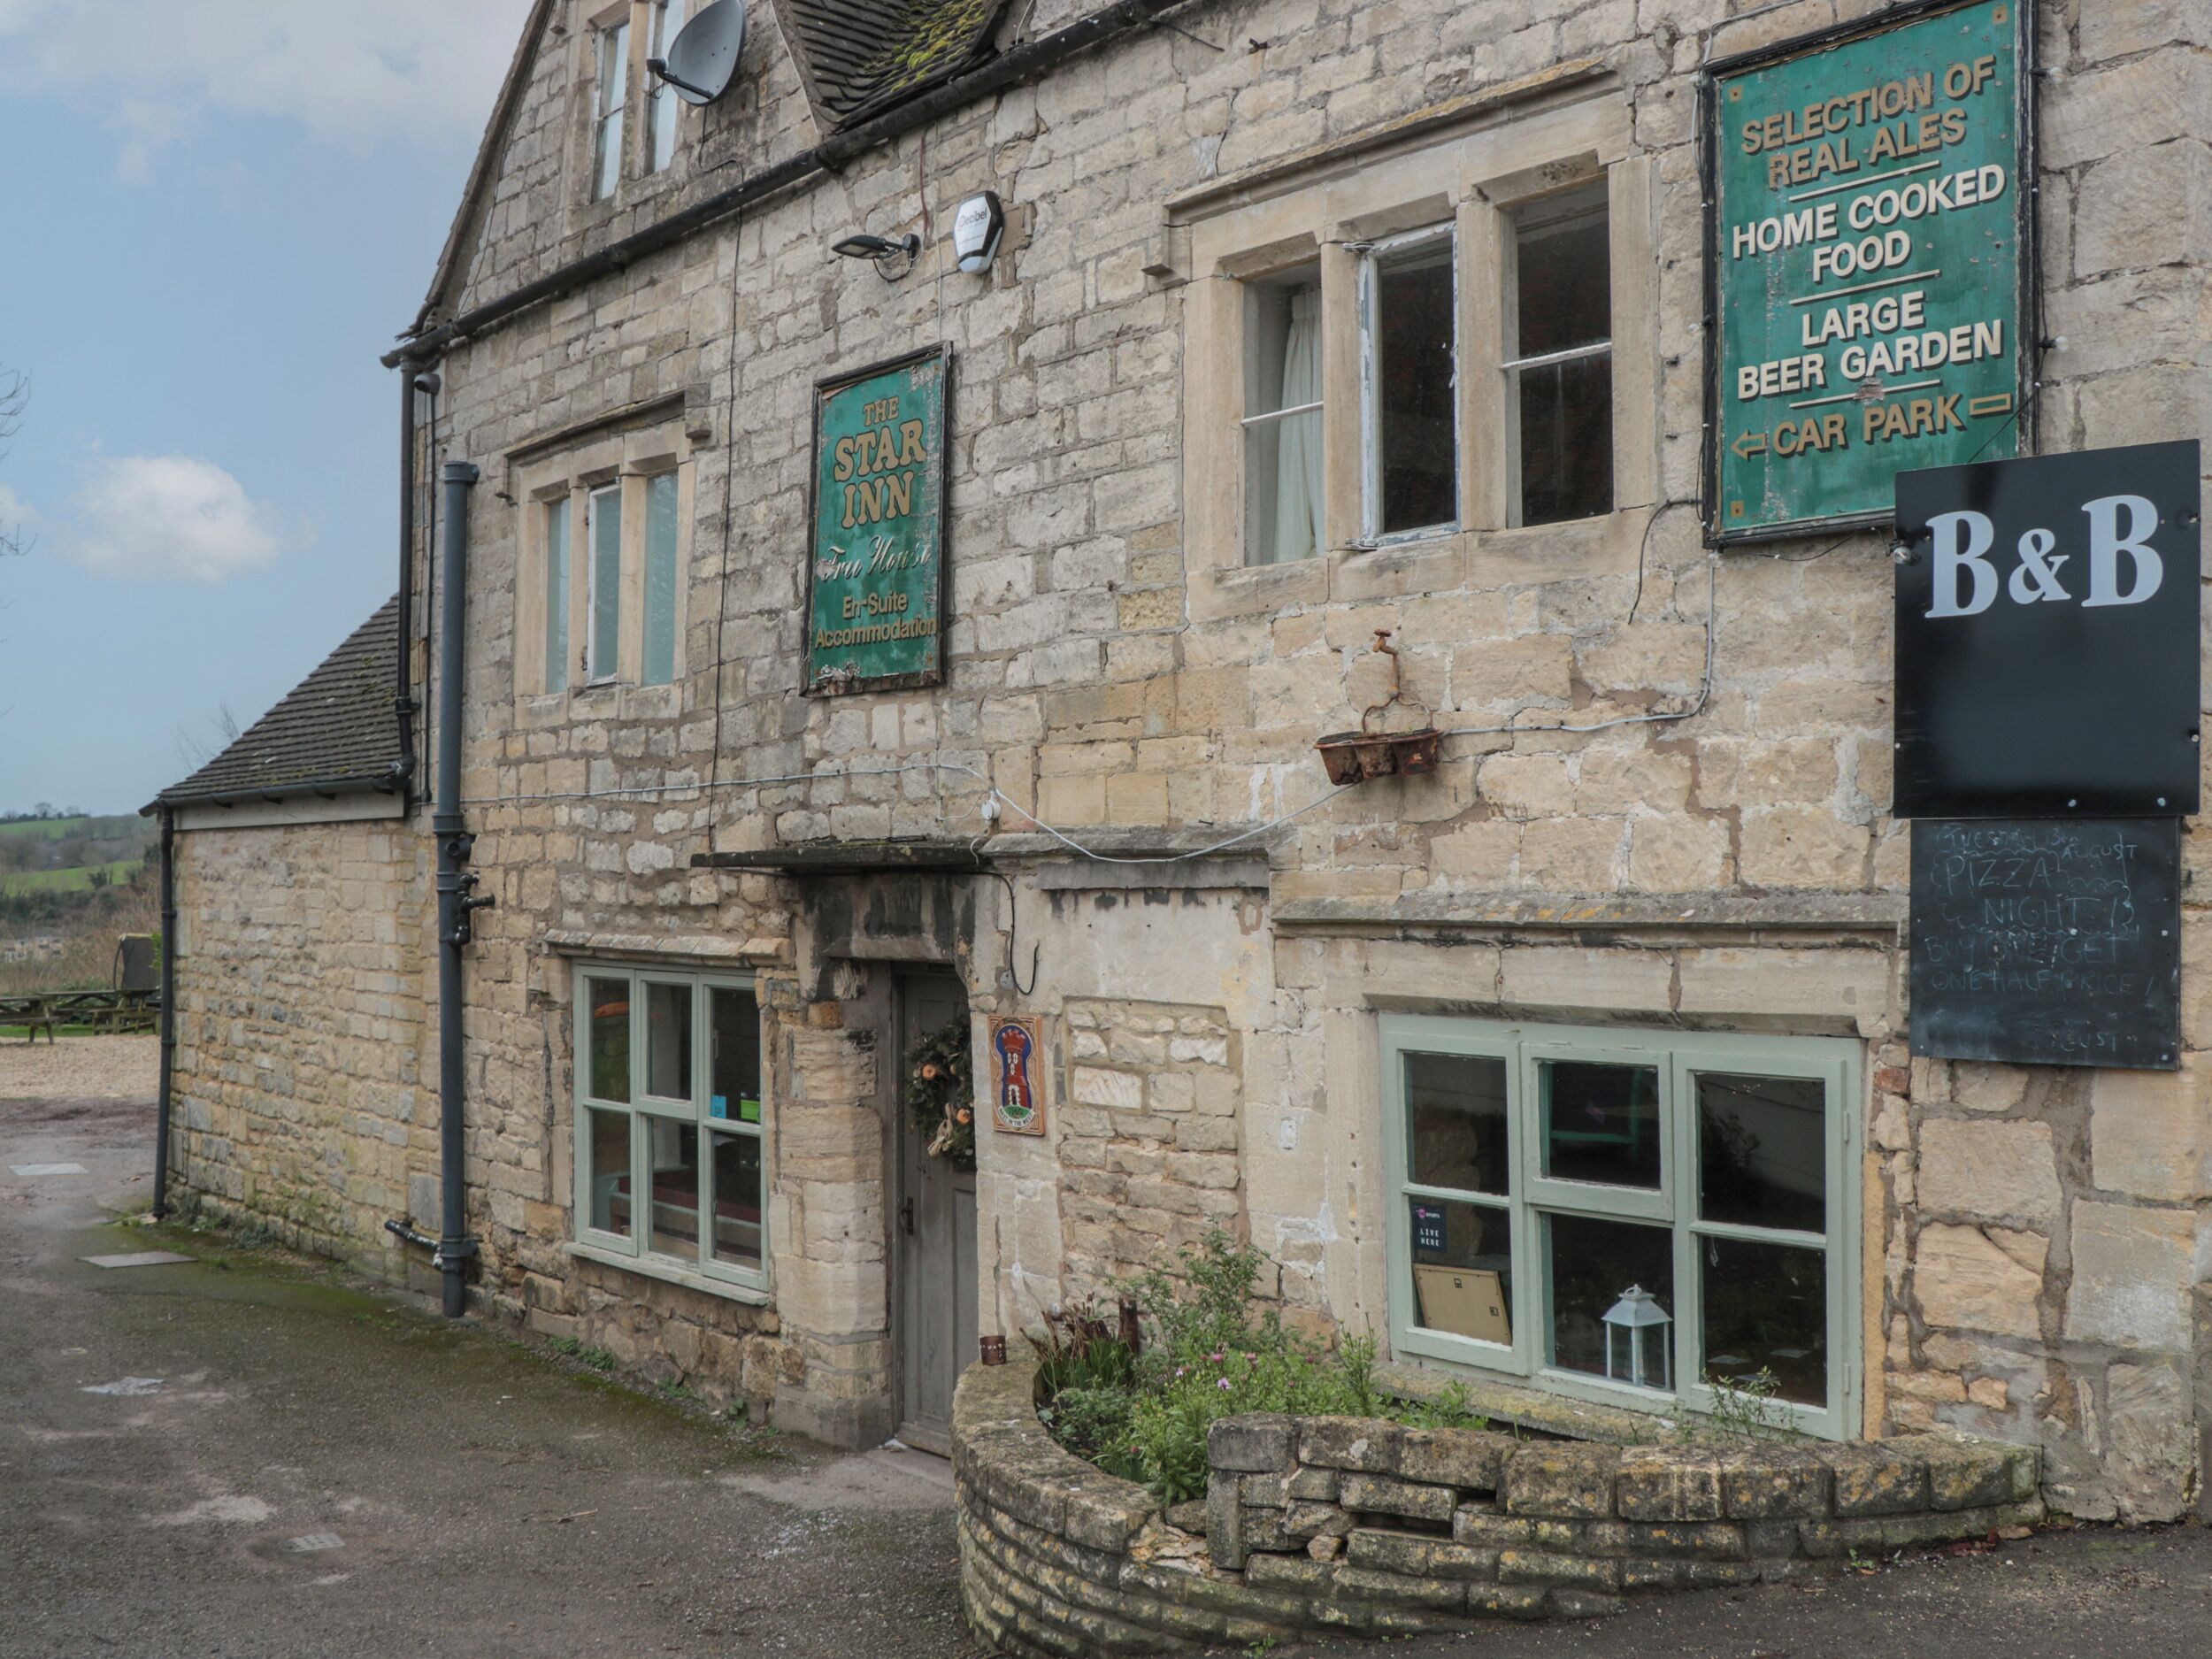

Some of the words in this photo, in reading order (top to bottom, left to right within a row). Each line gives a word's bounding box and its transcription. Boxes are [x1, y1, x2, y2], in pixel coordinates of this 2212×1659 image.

[1740, 71, 1934, 155] SELECTION
[1943, 54, 1997, 100] OF
[1769, 136, 1859, 191] REAL
[1868, 108, 1969, 165] ALES
[1732, 202, 1839, 260] HOME
[1848, 164, 2008, 231] COOKED
[1812, 228, 1912, 284] FOOD
[1801, 289, 1926, 348] LARGE
[1738, 353, 1828, 400] BEER
[1839, 319, 2004, 380] GARDEN
[863, 396, 900, 426] THE
[1772, 413, 1848, 457] CAR
[1863, 392, 1968, 443] PARK
[833, 419, 927, 482] STAR
[841, 470, 914, 529] INN
[1924, 495, 2164, 618] B&B
[814, 616, 938, 650] Accommodation
[842, 590, 910, 619] En-Suite
[1946, 855, 2052, 895] PIZZA
[2061, 842, 2139, 860] AUGUST
[1985, 895, 2101, 927] NIGHT
[1420, 1228, 1440, 1237] LIVE
